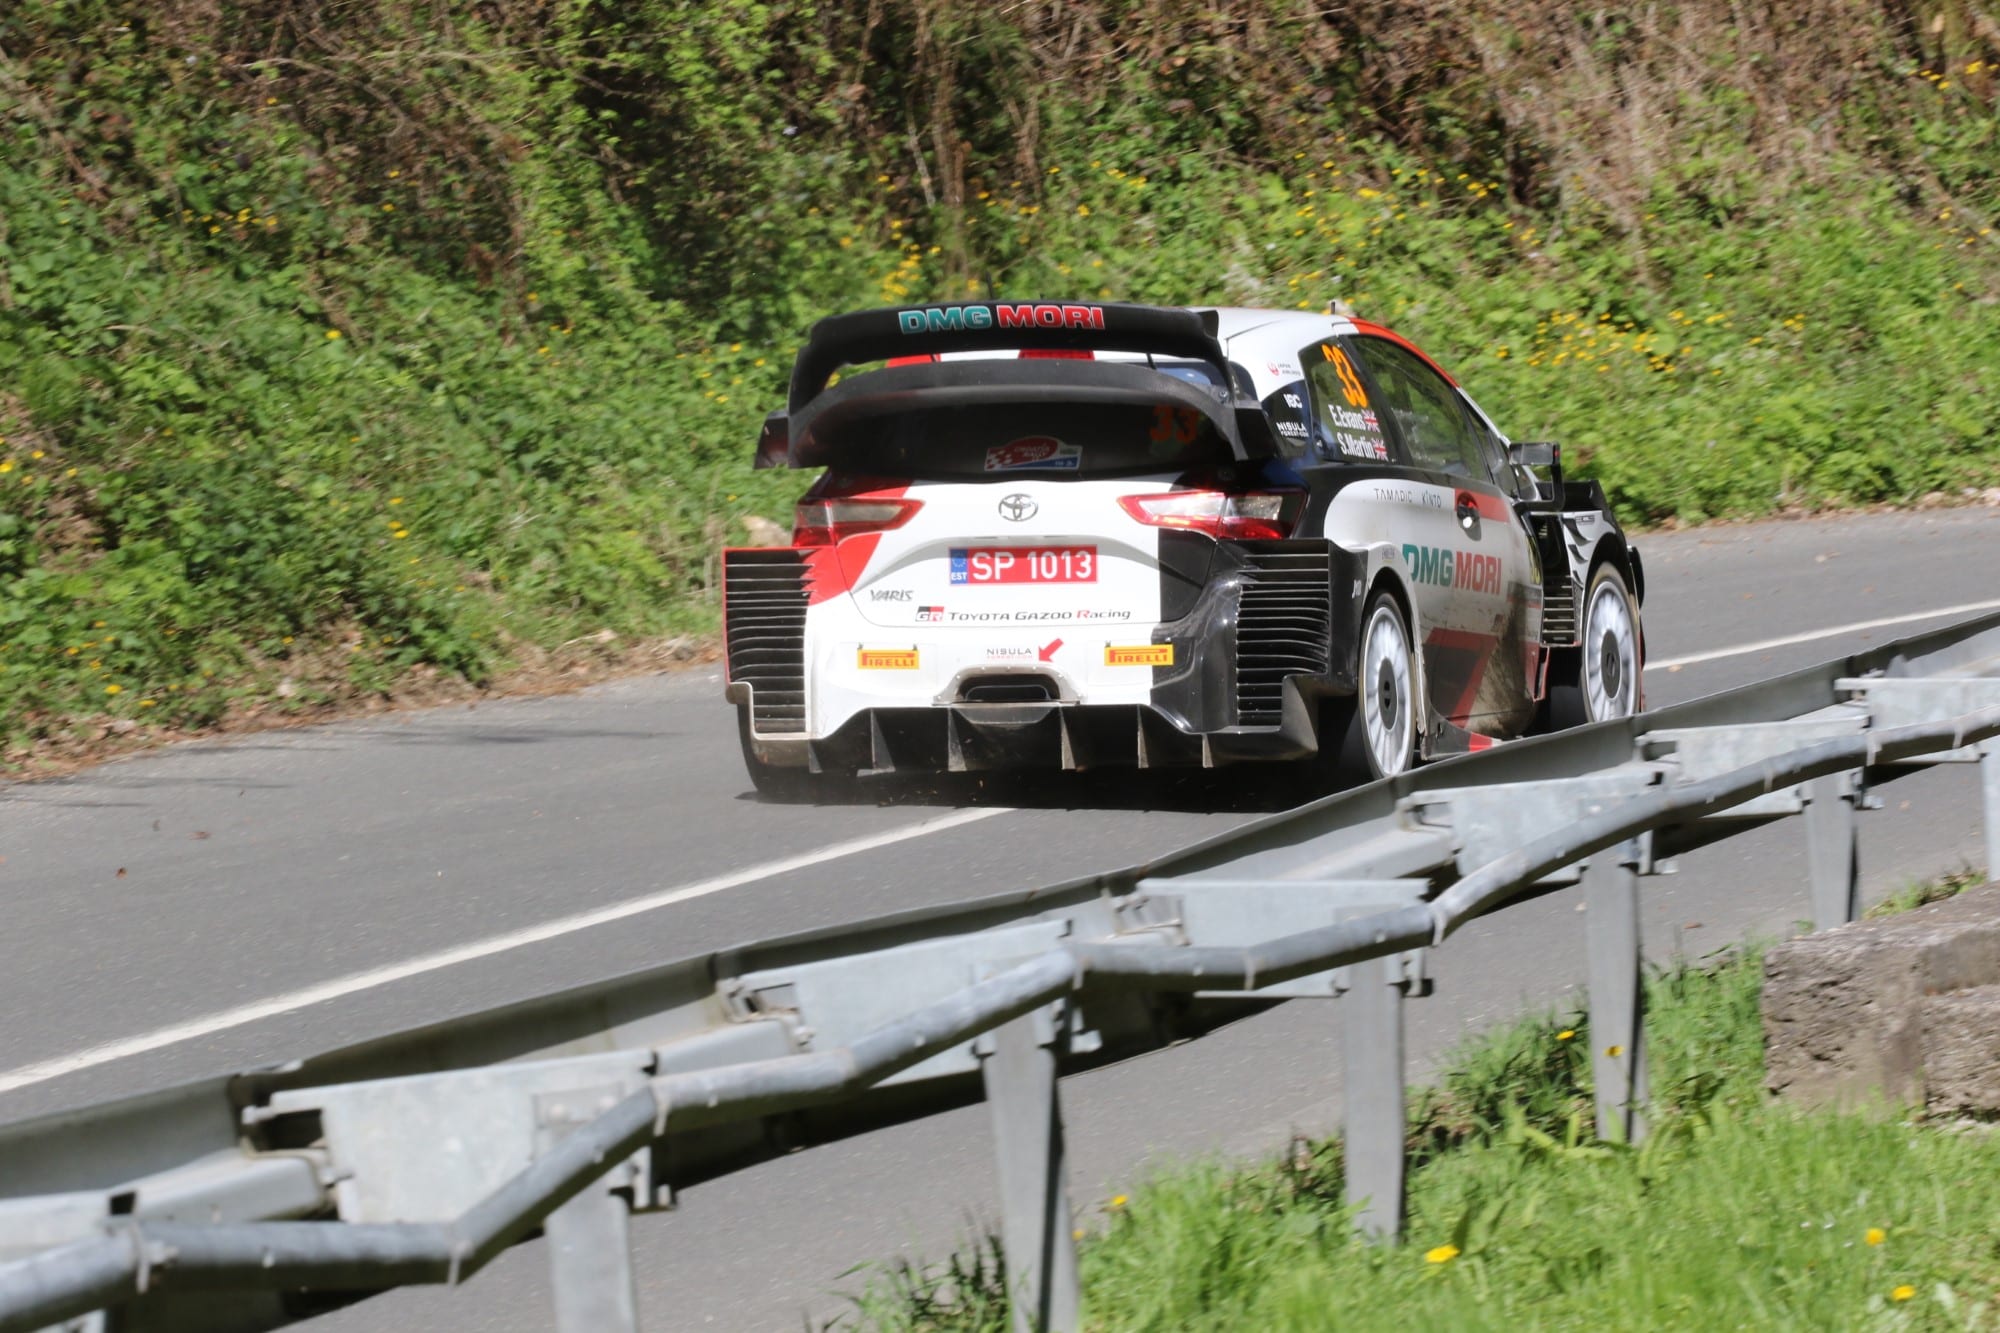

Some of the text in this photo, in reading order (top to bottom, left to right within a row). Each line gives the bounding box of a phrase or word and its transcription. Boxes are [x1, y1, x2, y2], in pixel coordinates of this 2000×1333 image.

[899, 305, 1105, 334] DMG MORI
[1322, 344, 1368, 408] 33
[1328, 404, 1366, 431] E.Evans
[1337, 432, 1376, 459] S.Martin
[951, 571, 967, 581] EST
[971, 550, 1092, 581] SP 1013
[1402, 543, 1454, 588] DMG
[1455, 551, 1502, 596] MORI
[915, 609, 1131, 622] GR TOYOTA GAZOO Racing
[862, 652, 915, 667] PIRELLI
[986, 647, 1032, 655] NISULA
[1109, 648, 1168, 664] PIRELLI
